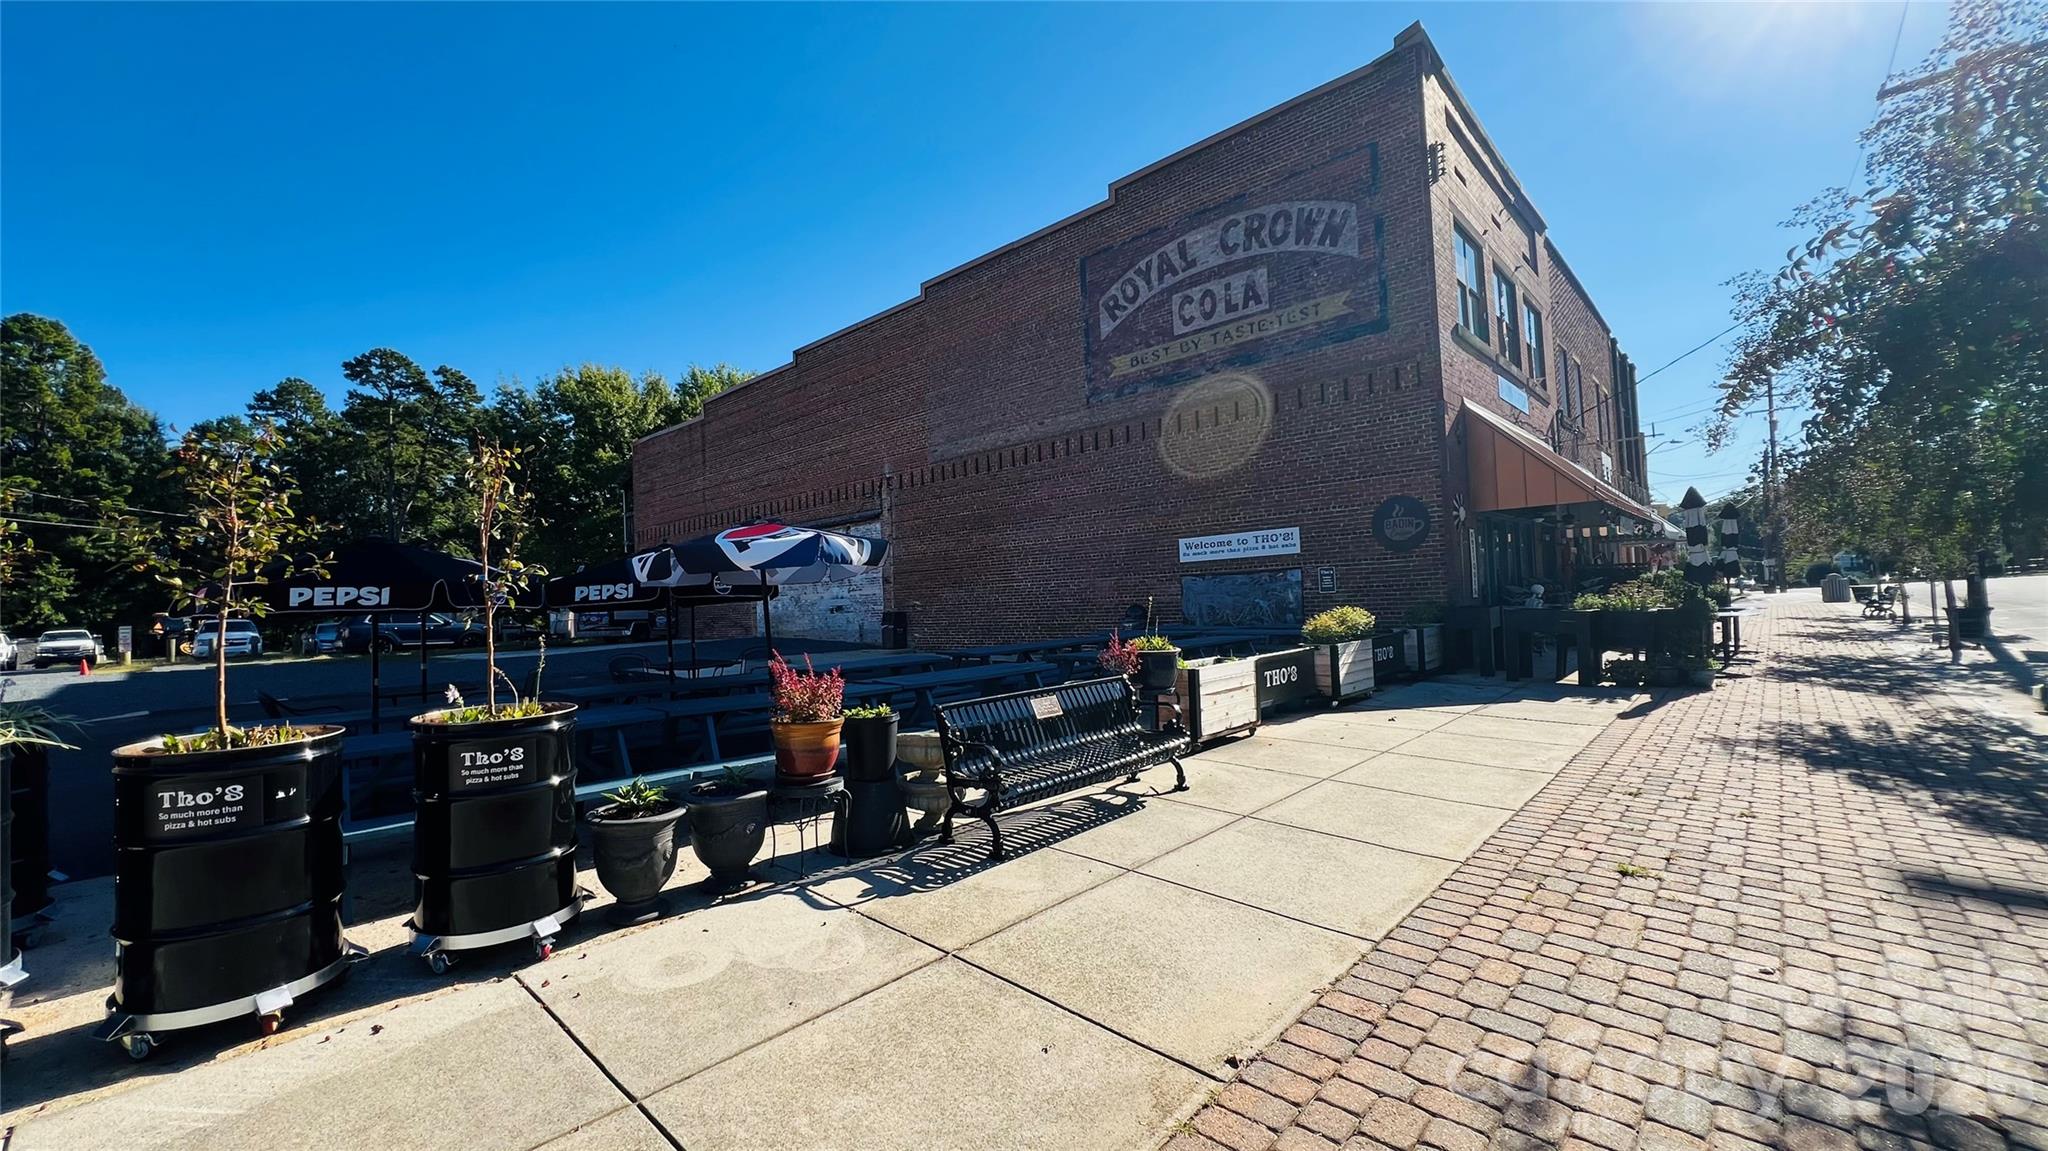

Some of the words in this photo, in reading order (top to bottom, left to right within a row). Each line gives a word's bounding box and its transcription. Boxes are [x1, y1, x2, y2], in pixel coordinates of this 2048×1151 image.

[1102, 238, 1198, 323] ROYAL
[1219, 207, 1351, 254] CROWN
[1177, 276, 1264, 327] COLA
[1129, 346, 1170, 369] BEST
[1179, 333, 1202, 354] BY
[1385, 518, 1415, 529] BADIN
[1184, 540, 1232, 551] Welcome
[1237, 538, 1249, 546] to
[1253, 531, 1294, 544] THO'S!
[289, 586, 391, 607] PEPSI
[574, 583, 634, 602] PEPSI
[1263, 665, 1298, 688] THO'S
[465, 777, 483, 785] pizza
[158, 812, 169, 820] So
[170, 810, 195, 819] much
[196, 808, 221, 817] more
[222, 805, 243, 814] than
[164, 822, 186, 831] pizza
[188, 820, 195, 828] &
[197, 818, 213, 827] hot
[214, 815, 237, 825] subs
